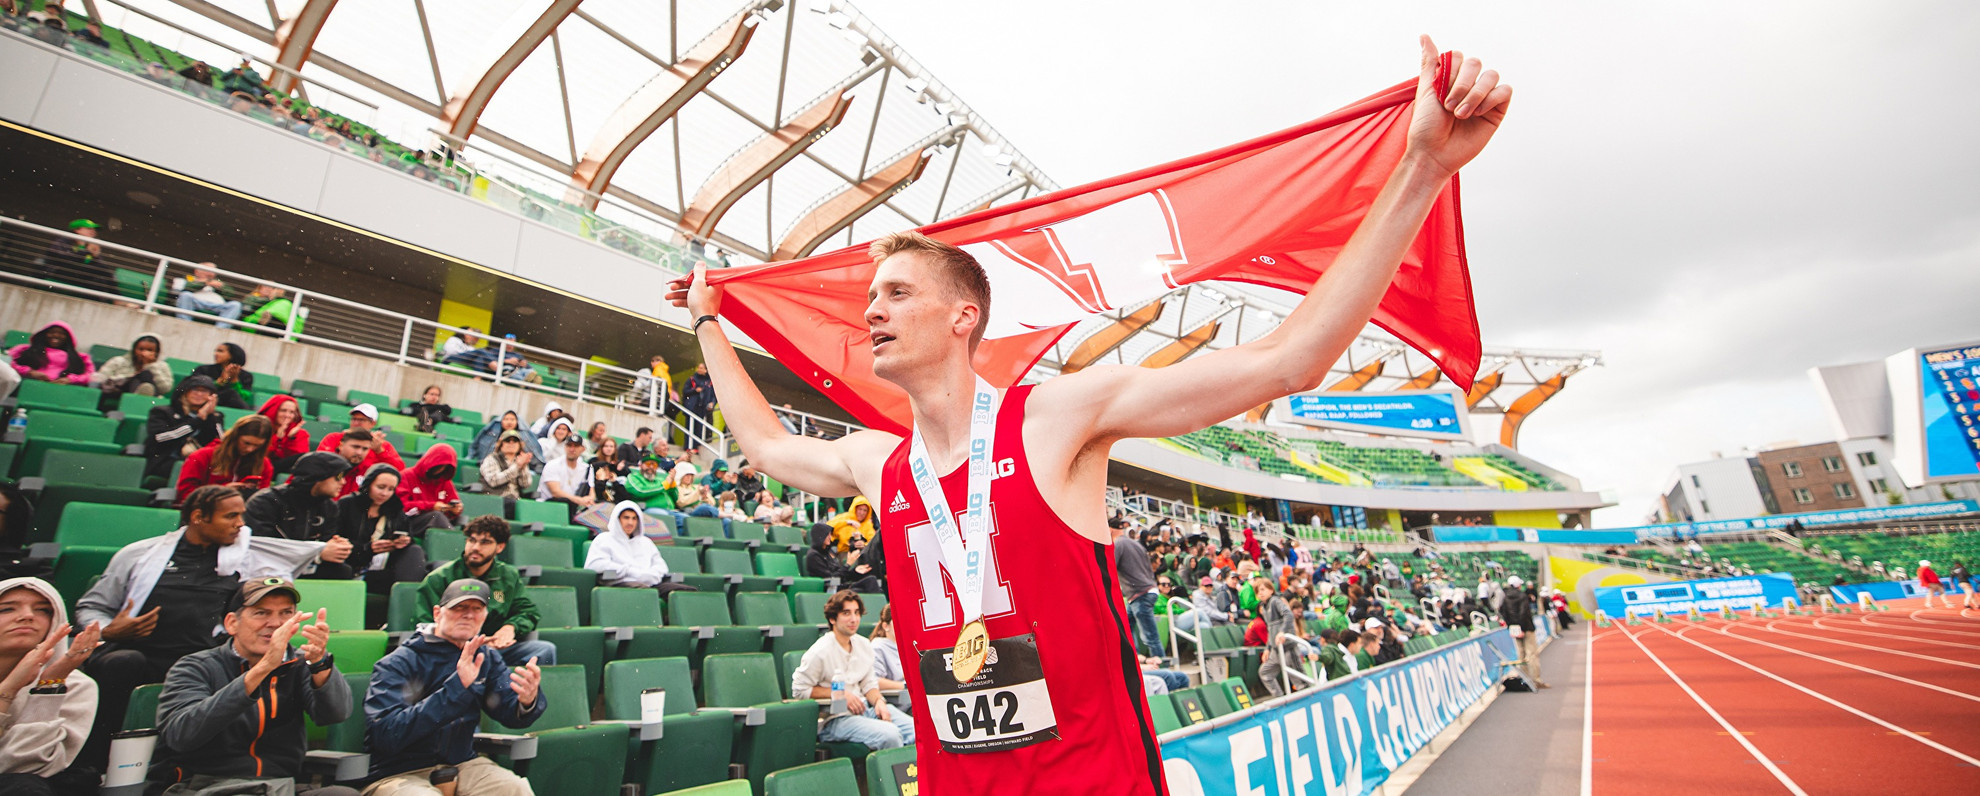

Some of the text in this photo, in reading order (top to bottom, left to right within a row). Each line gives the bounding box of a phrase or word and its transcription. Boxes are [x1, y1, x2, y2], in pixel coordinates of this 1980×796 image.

[888, 502, 910, 513] adidas
[957, 679, 994, 689] CHAMPIONSHIPS
[946, 690, 1025, 740] 642
[1367, 641, 1492, 772] CHAMPIONSHIPS
